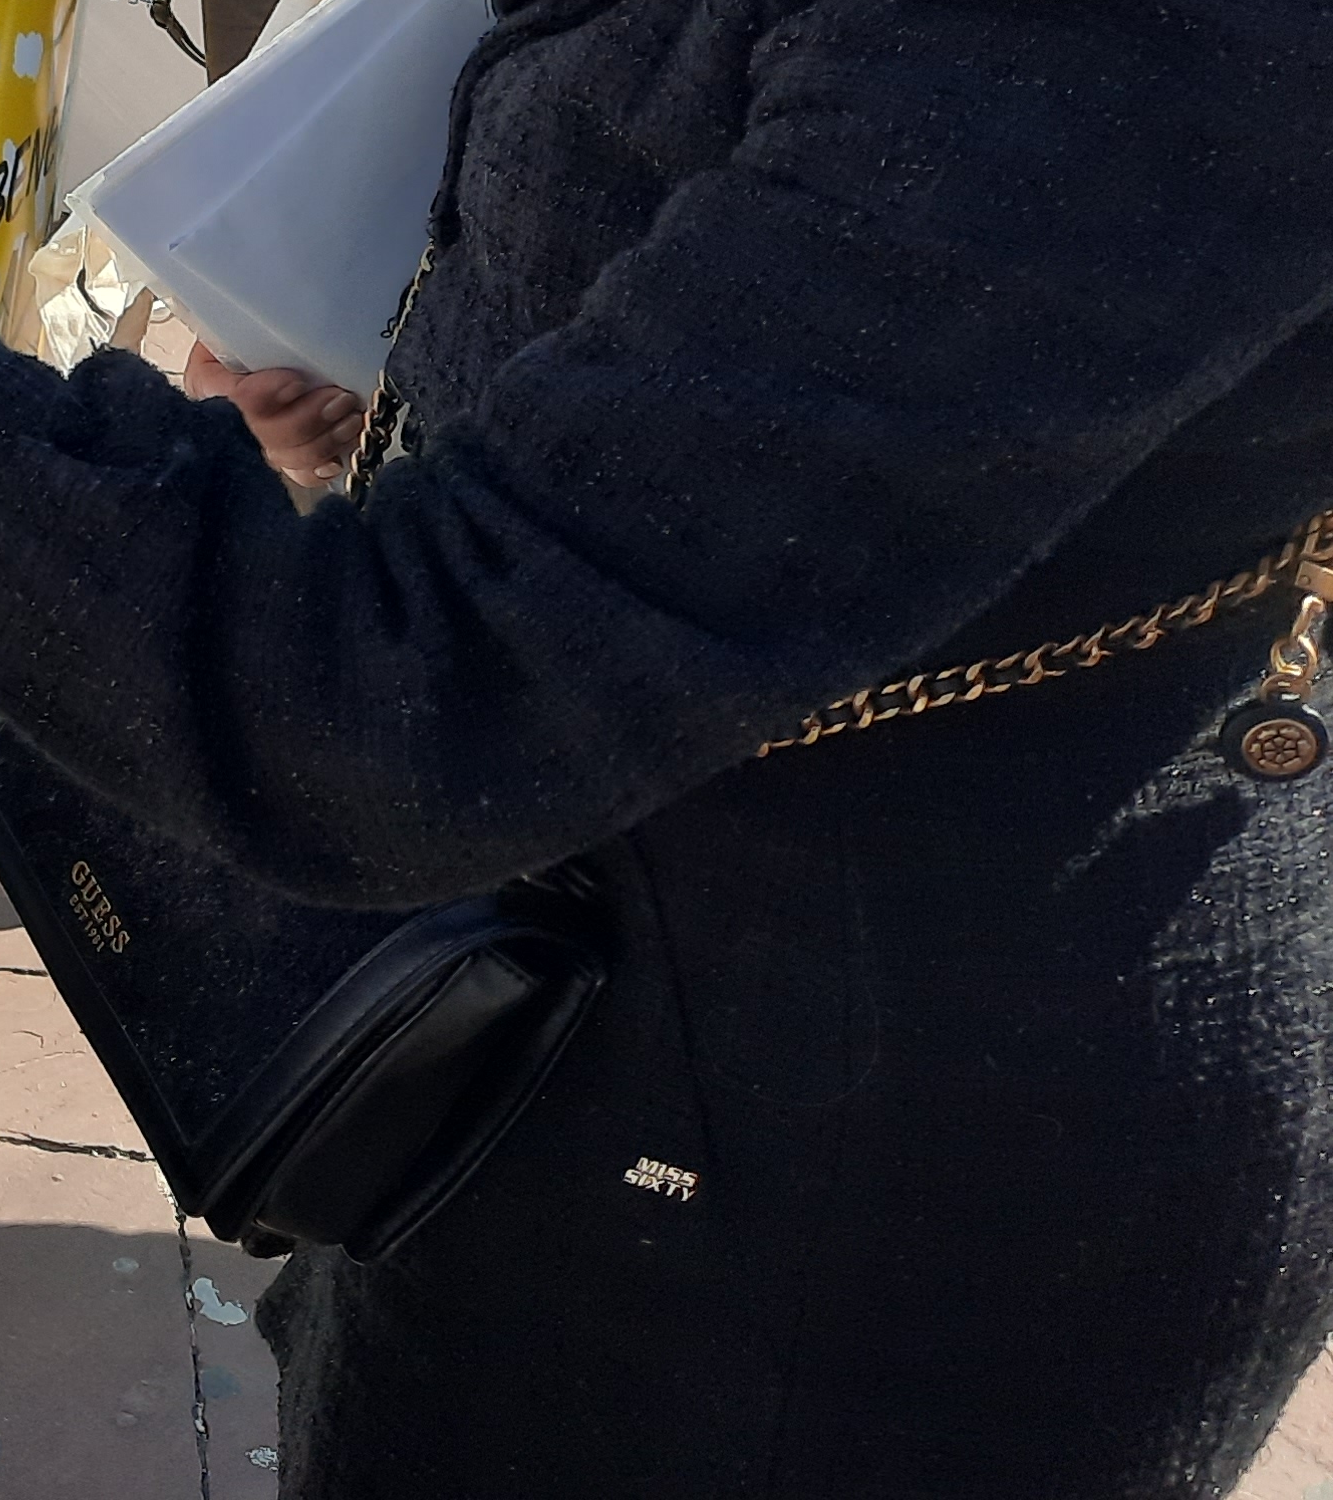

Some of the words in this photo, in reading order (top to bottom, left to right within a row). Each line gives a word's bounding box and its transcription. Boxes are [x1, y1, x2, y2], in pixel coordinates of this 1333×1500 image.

[71, 860, 130, 953] GUESS
[622, 1168, 696, 1202] SIXTY
[635, 1156, 699, 1188] MISS
